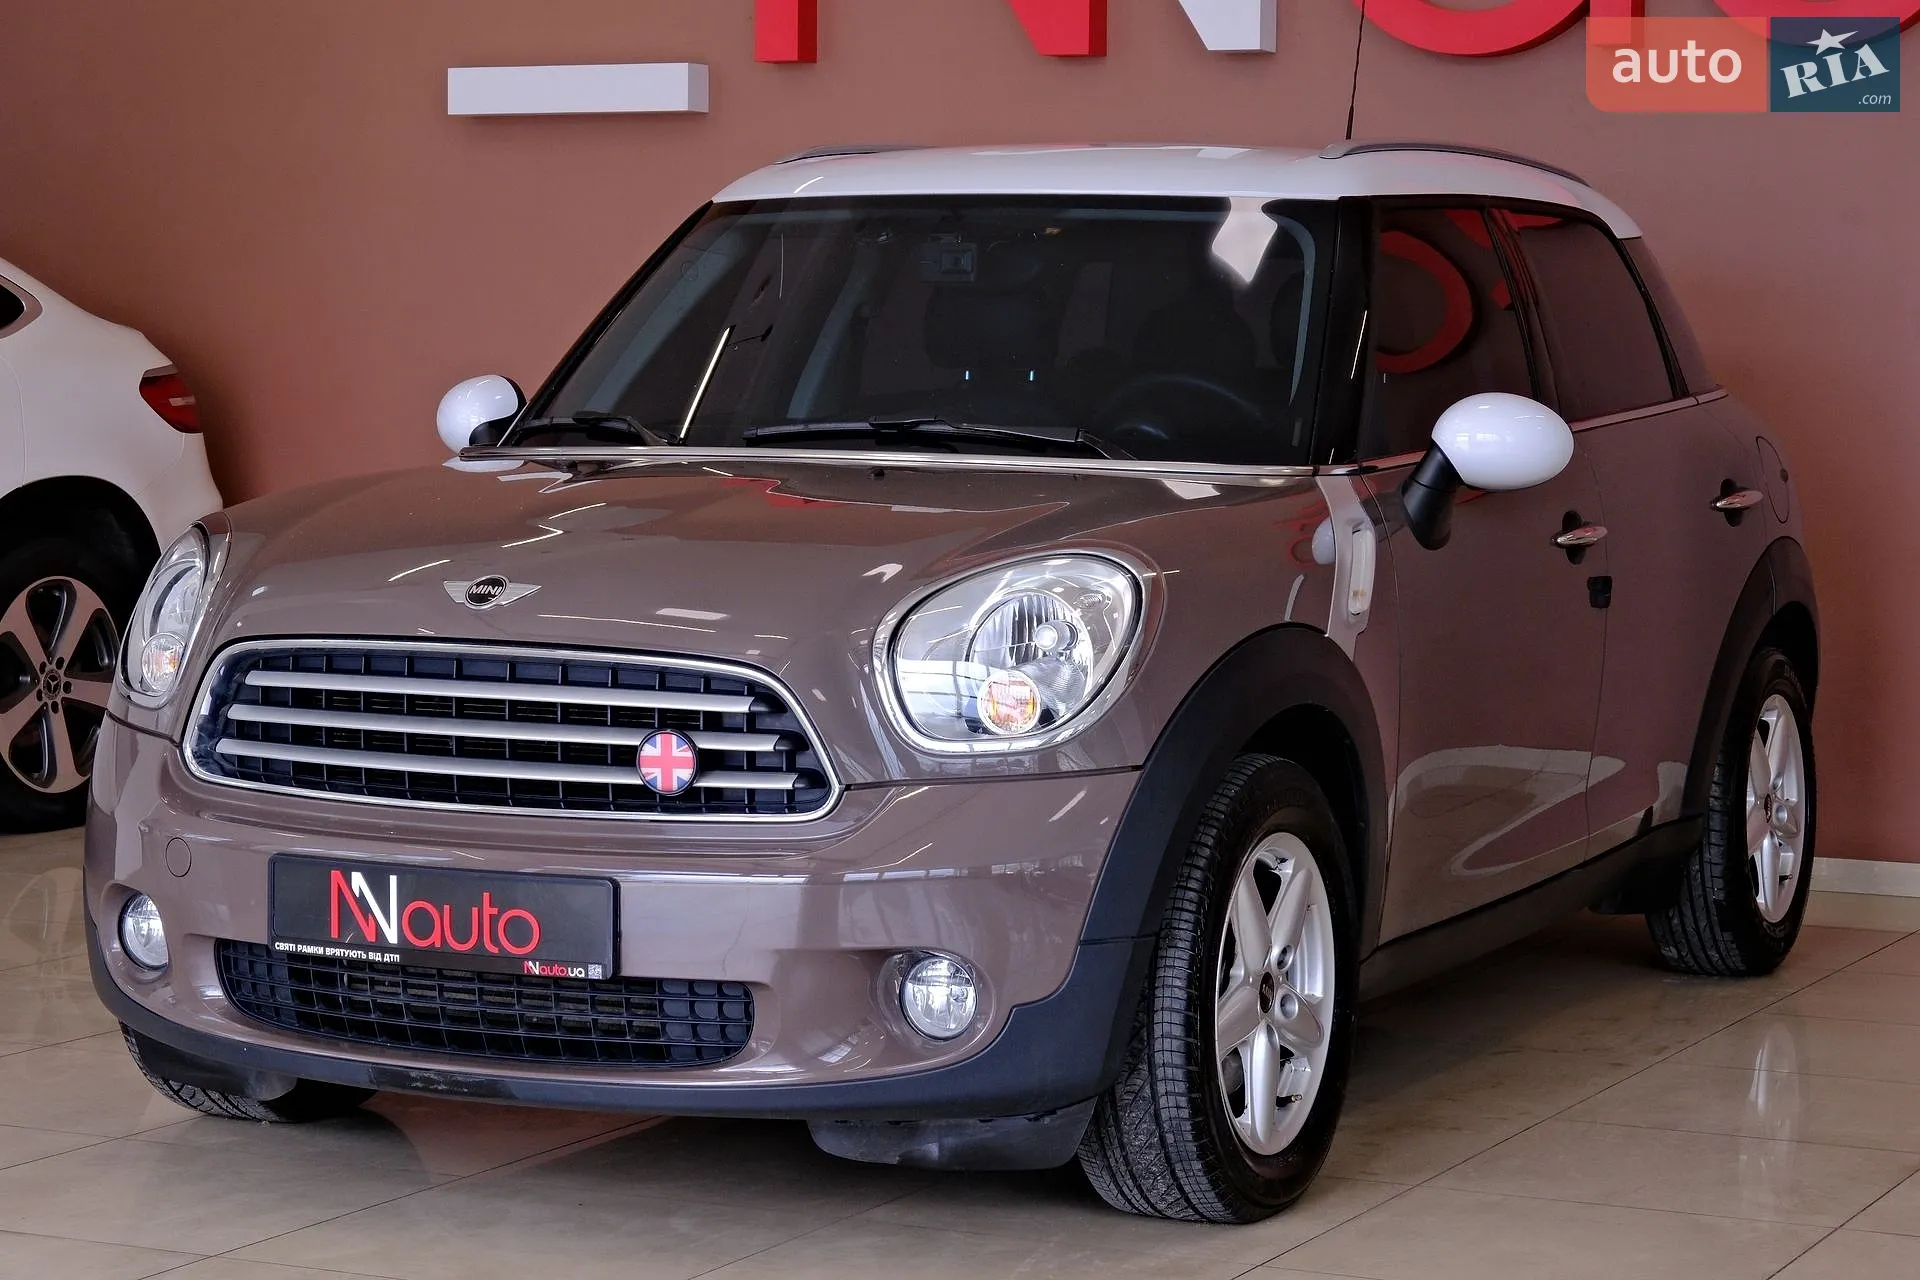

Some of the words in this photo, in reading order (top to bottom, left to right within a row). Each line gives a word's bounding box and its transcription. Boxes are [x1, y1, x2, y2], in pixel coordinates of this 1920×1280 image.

[469, 584, 502, 595] MINI
[275, 941, 296, 952] СВЯТІ
[297, 944, 324, 955] РАМКИ
[325, 947, 366, 959] ВРЯТУЮТЬ
[368, 951, 382, 962] ВІД
[383, 953, 400, 963] ДТП
